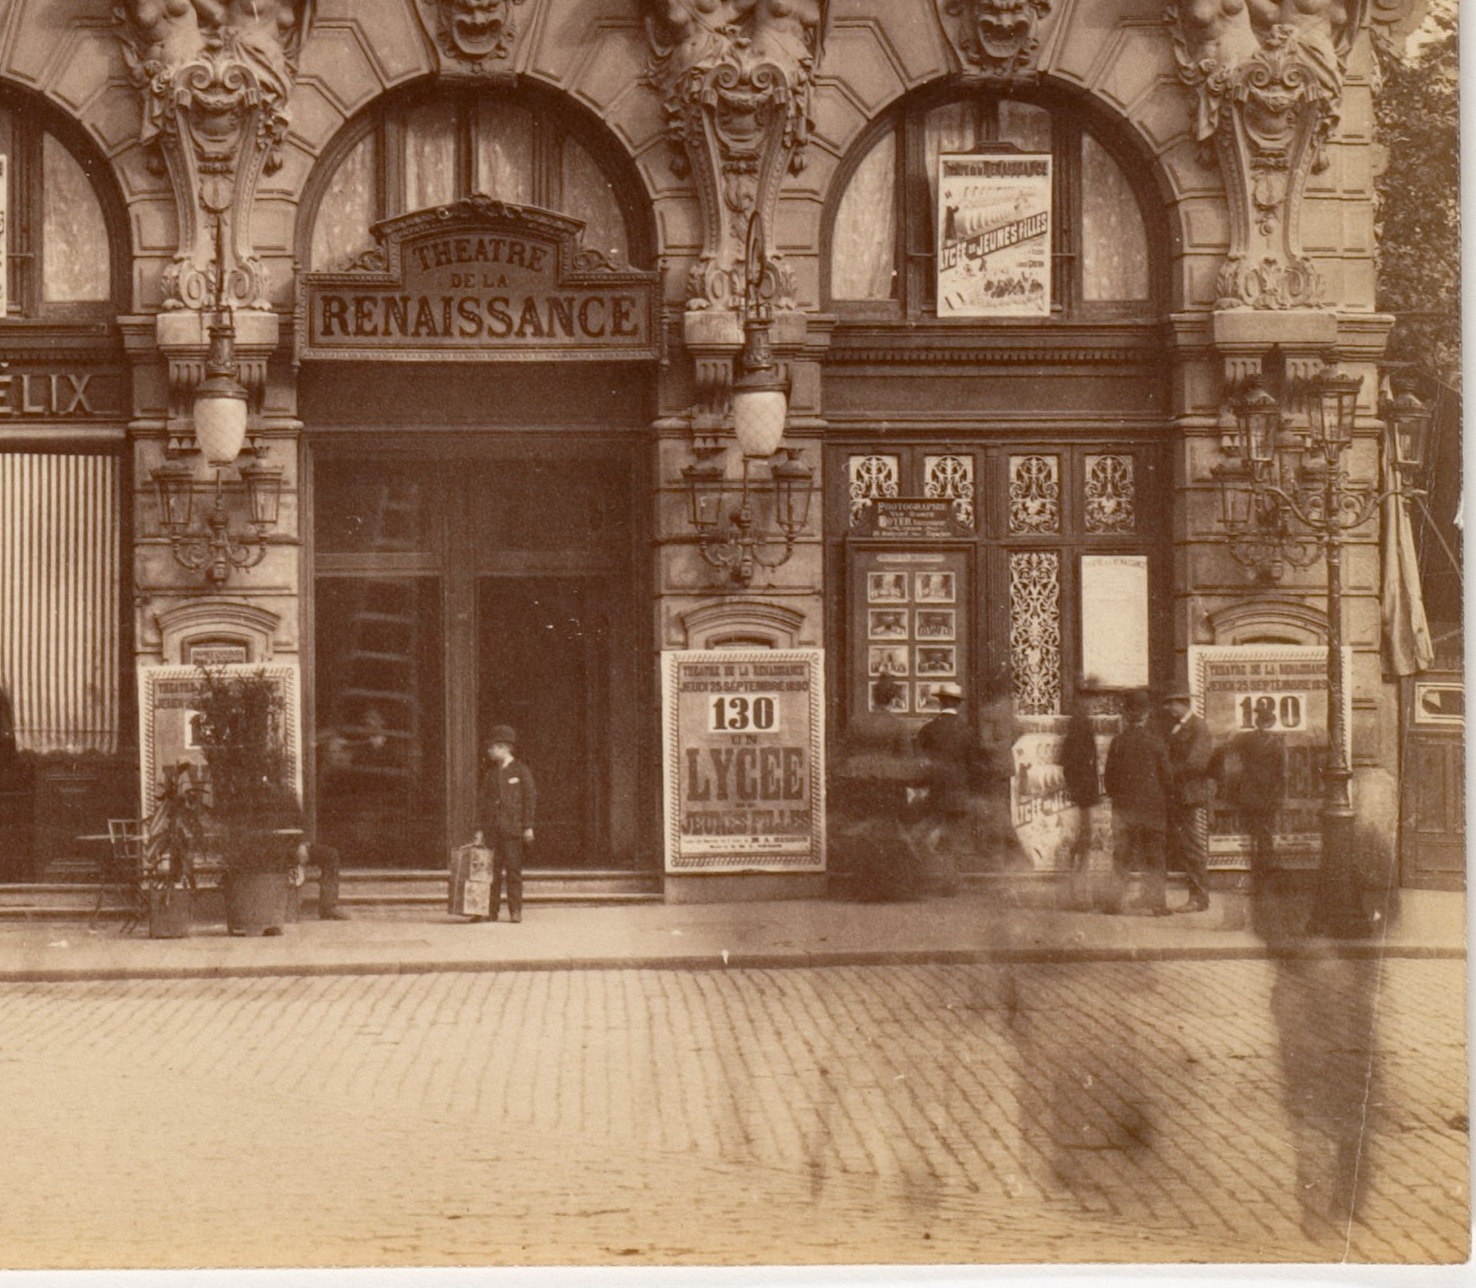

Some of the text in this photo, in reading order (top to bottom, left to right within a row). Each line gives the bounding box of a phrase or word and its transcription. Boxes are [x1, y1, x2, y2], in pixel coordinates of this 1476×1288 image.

[411, 237, 548, 273] THEATRE
[451, 273, 508, 289] DE LA
[319, 294, 640, 339] RENAISSANCE
[738, 665, 750, 677] LA
[723, 681, 785, 693] SEPTEMBRE
[712, 696, 775, 731] 130
[730, 734, 758, 746] UN
